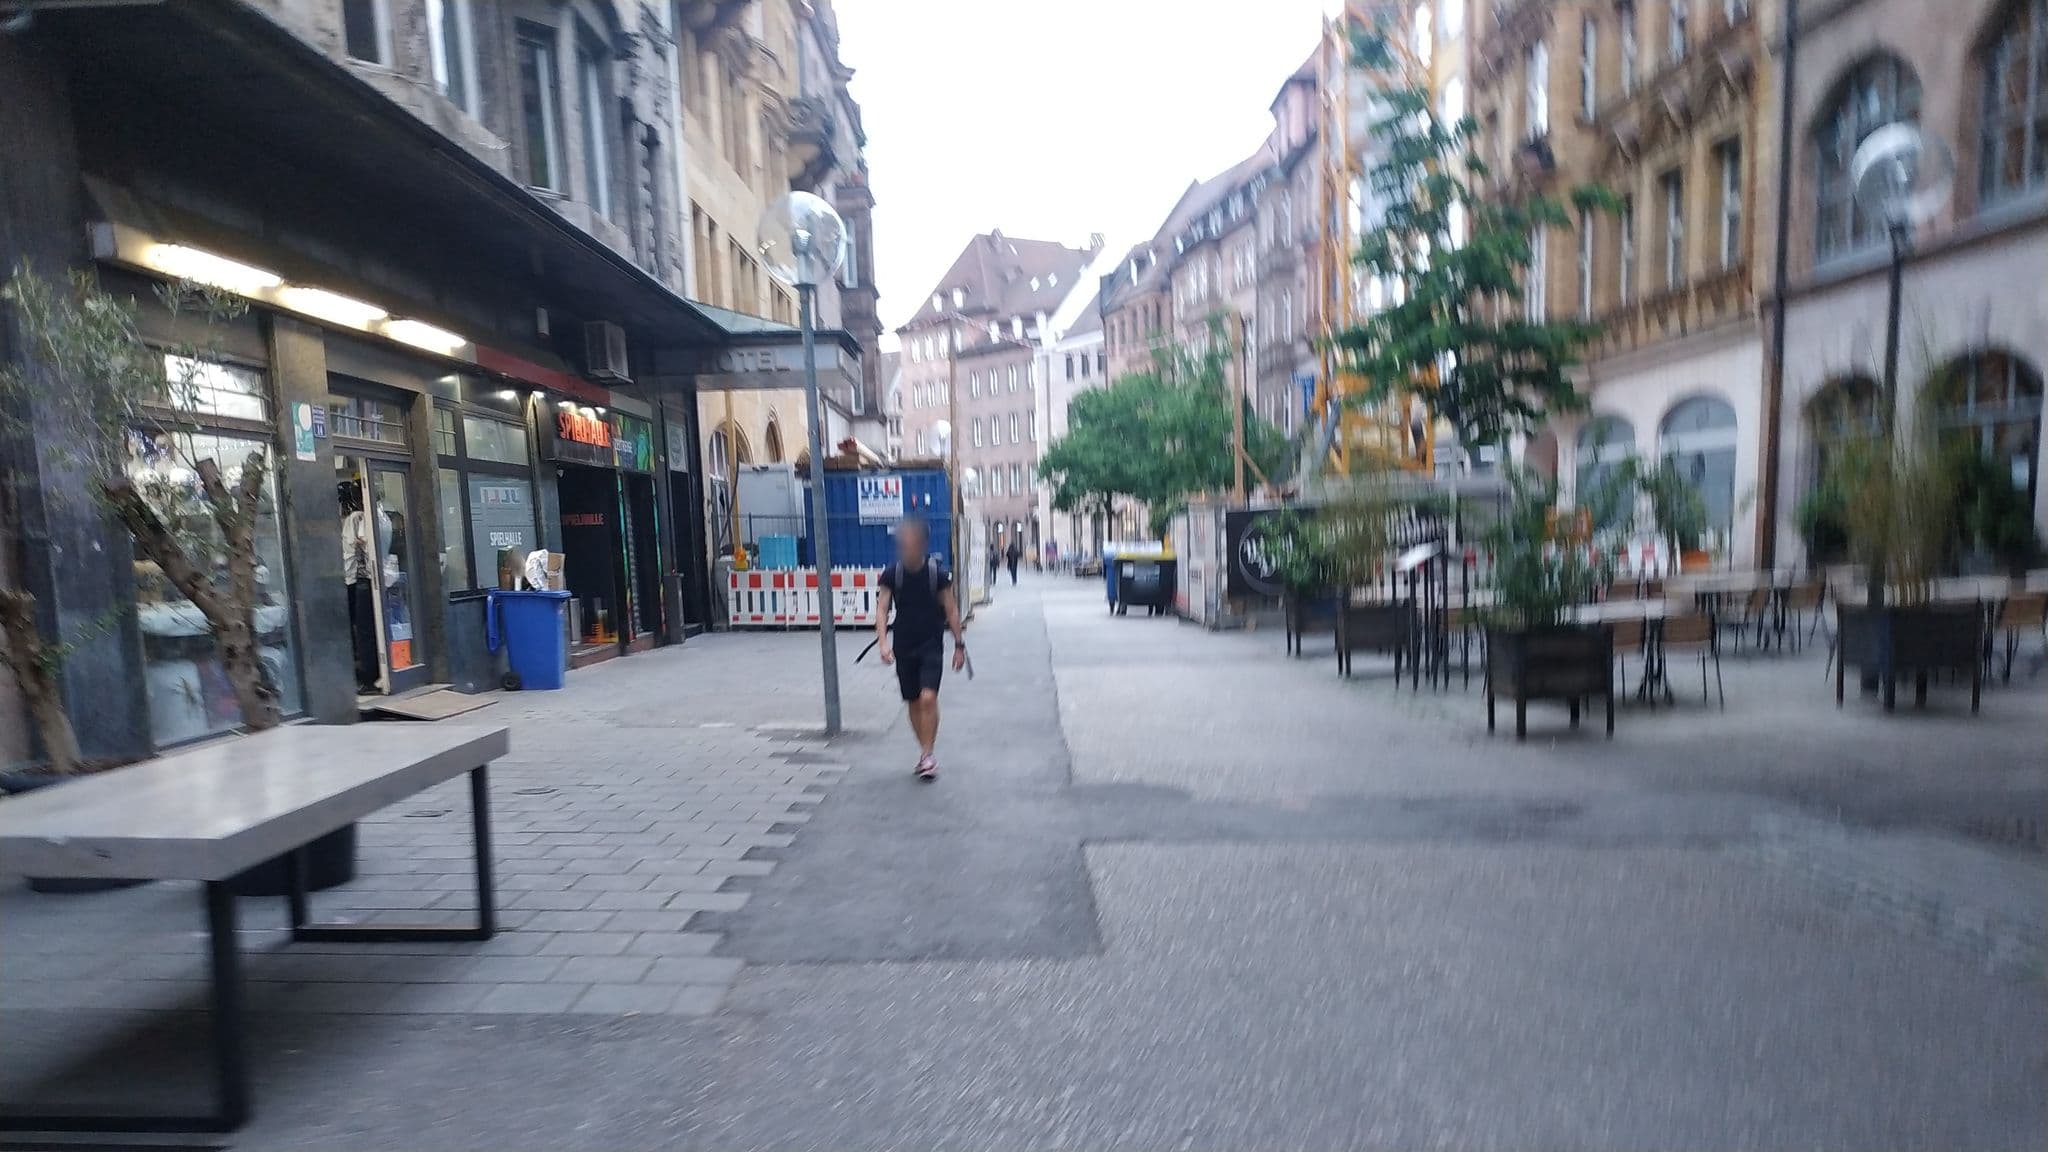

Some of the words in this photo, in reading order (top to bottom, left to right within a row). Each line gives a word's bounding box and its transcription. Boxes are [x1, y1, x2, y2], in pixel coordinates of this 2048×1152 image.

[714, 350, 791, 373] OTEL
[559, 411, 611, 448] SPIELHALLE
[489, 531, 523, 547] SPIELHALLE
